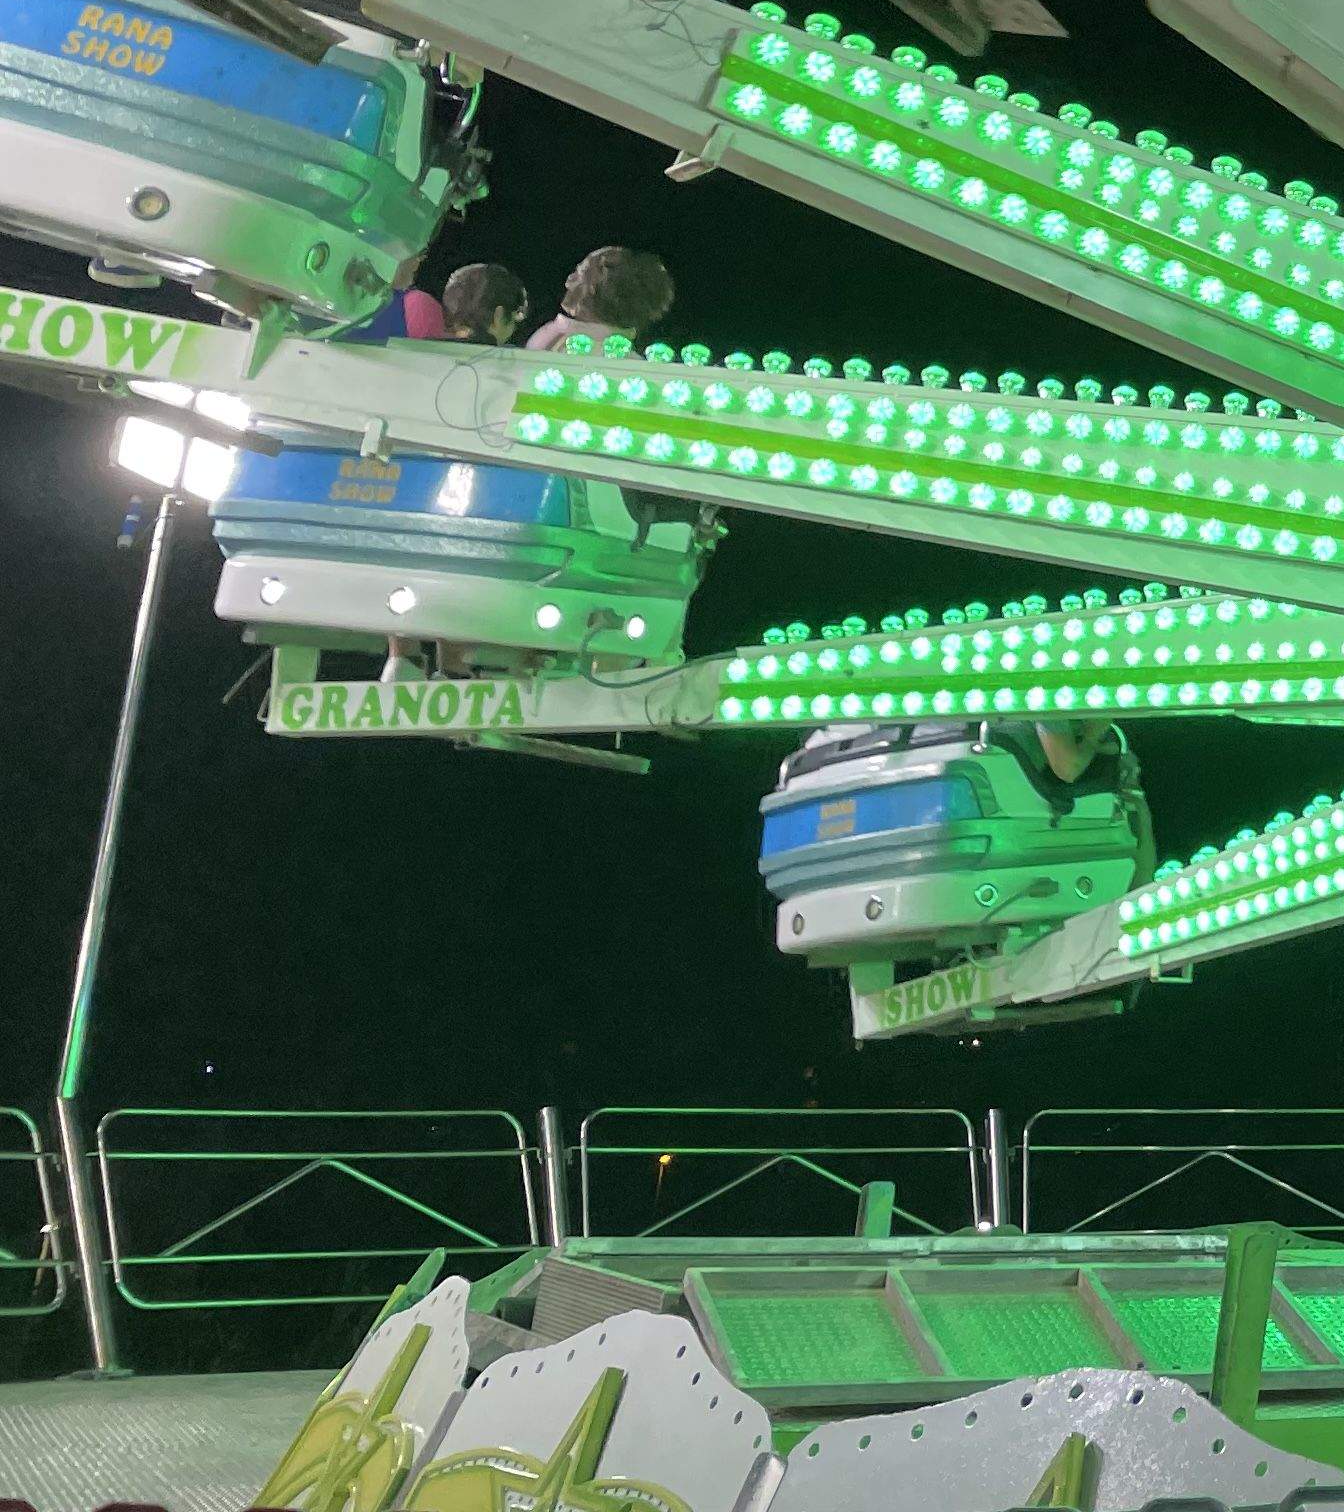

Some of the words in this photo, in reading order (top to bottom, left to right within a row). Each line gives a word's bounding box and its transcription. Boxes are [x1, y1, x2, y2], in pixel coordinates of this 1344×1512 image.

[79, 4, 173, 50] RANA
[61, 30, 166, 76] SHOW
[281, 681, 525, 730] GRANOTA
[884, 967, 976, 1027] SHOW
